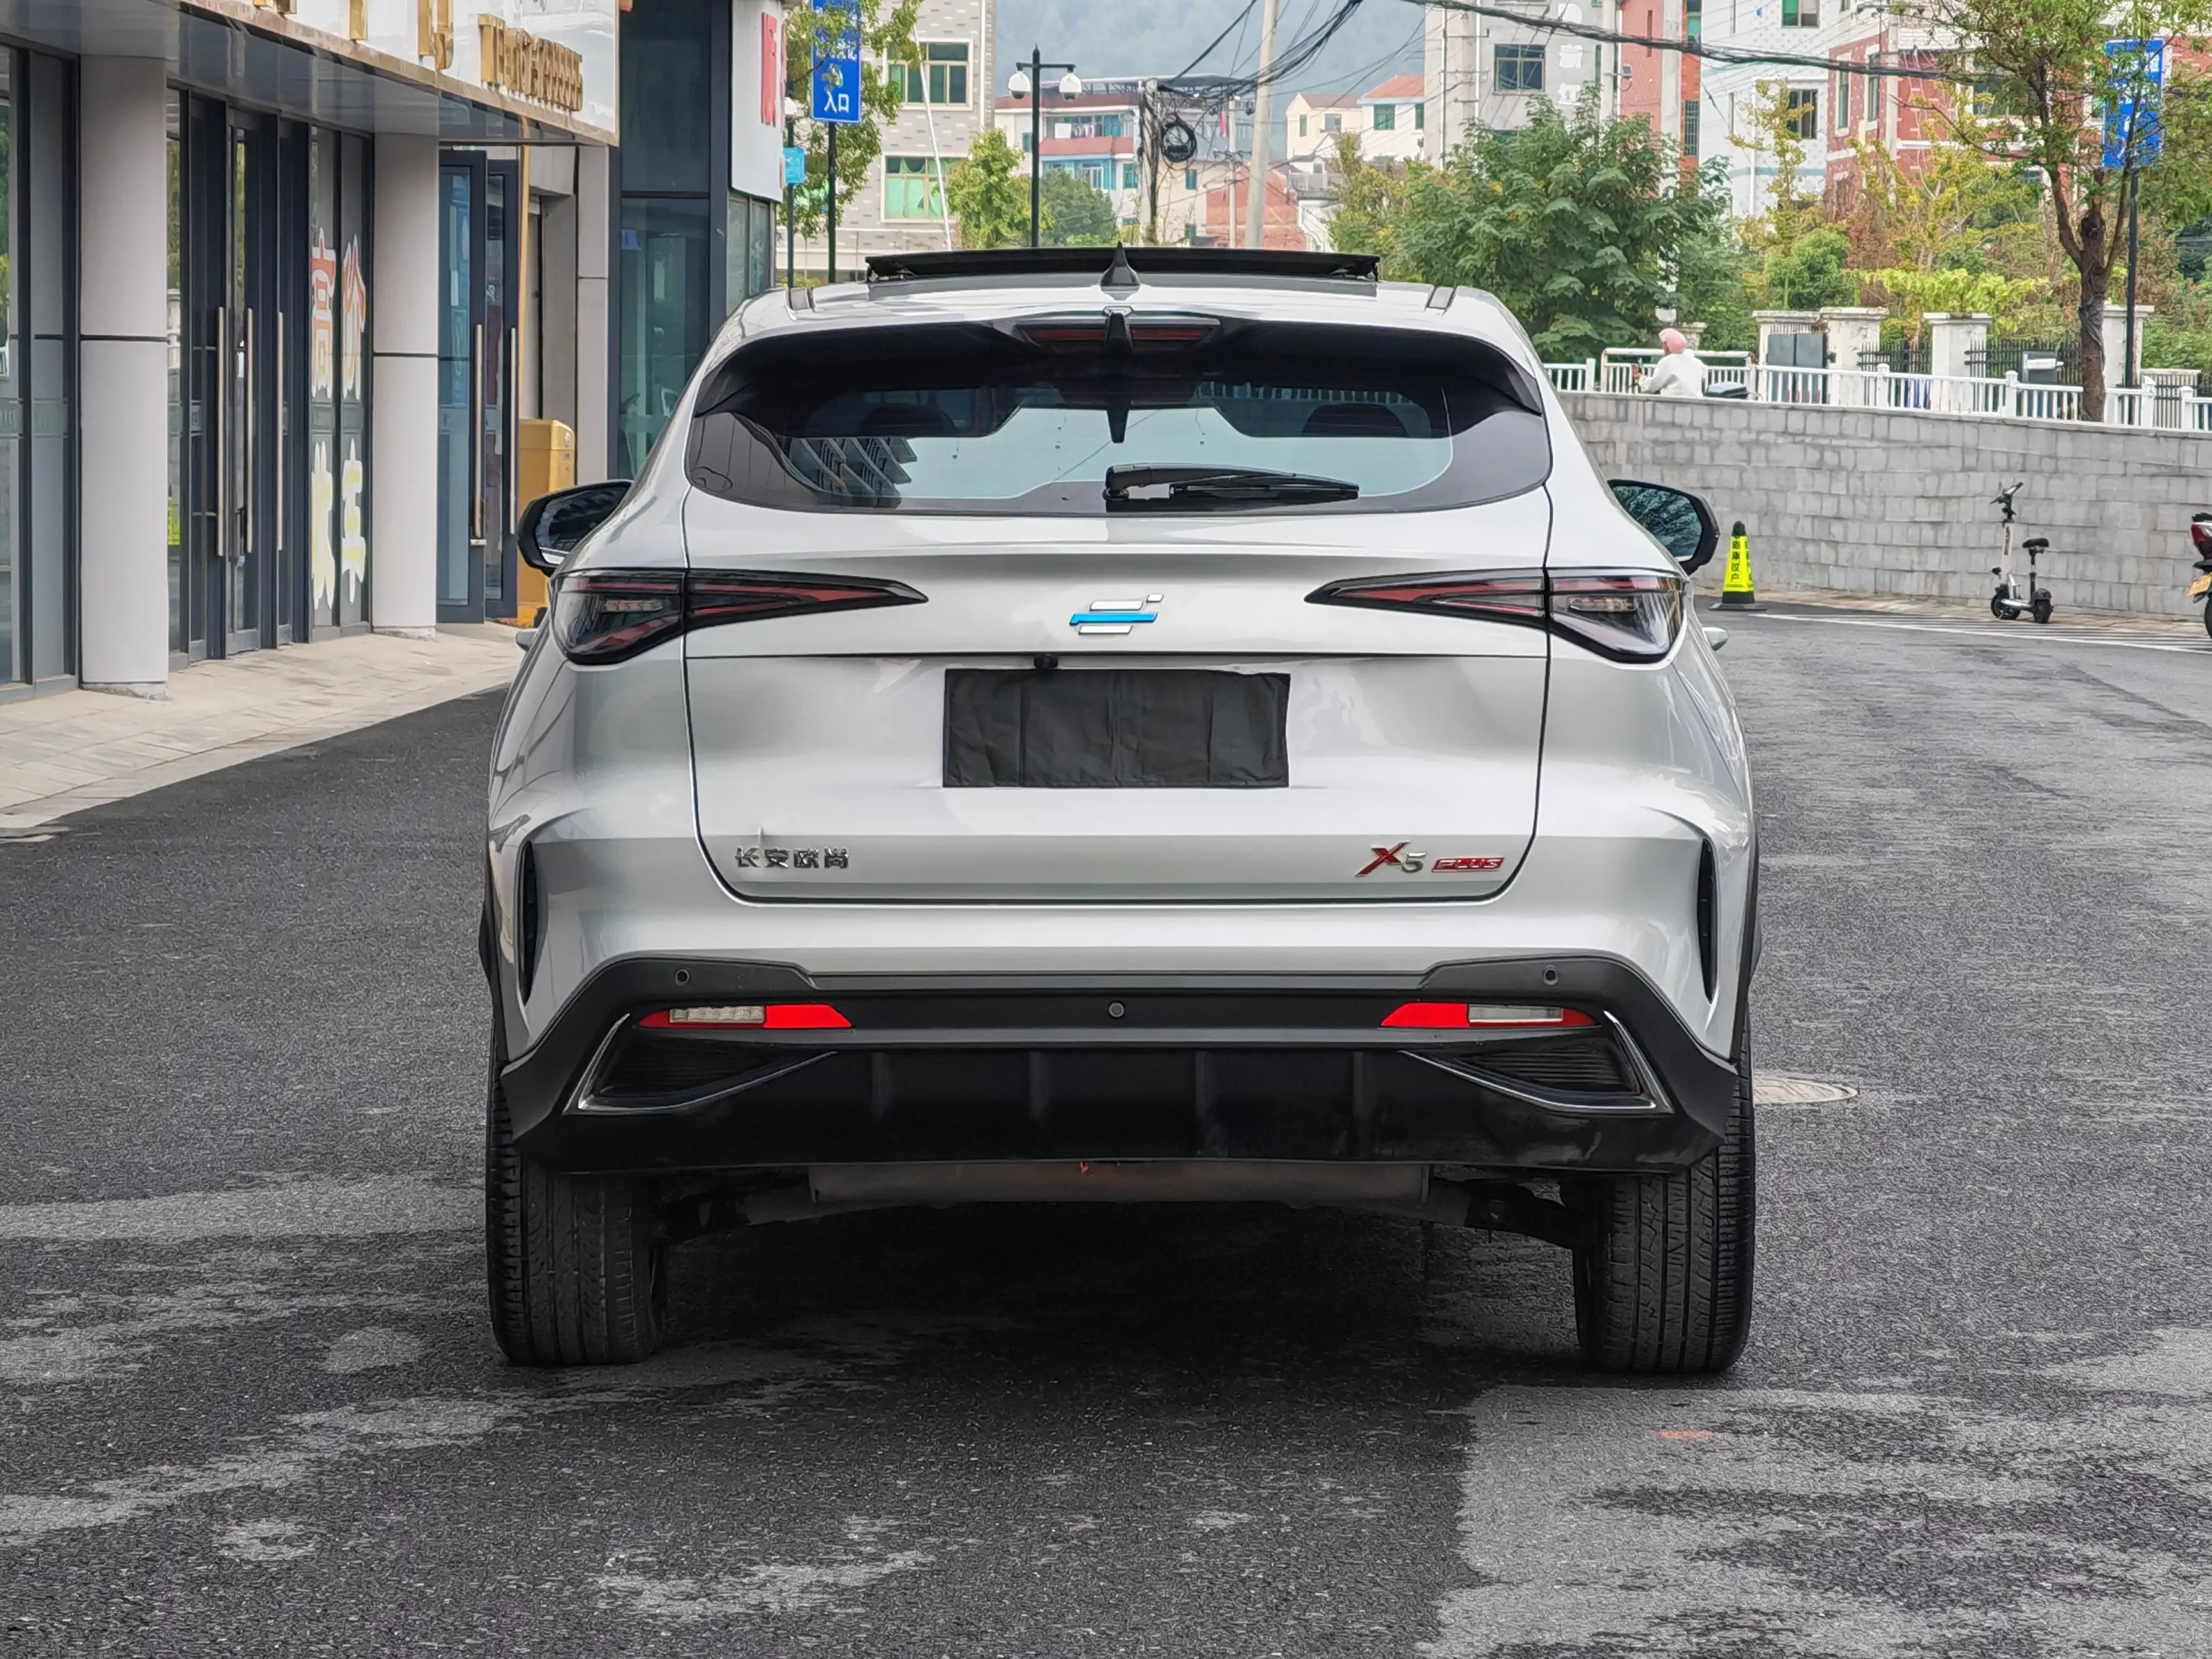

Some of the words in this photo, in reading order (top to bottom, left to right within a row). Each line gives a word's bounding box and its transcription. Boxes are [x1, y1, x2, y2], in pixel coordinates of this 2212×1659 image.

[824, 90, 849, 113] 入口
[735, 846, 849, 868] 长安欧尚
[1354, 840, 1428, 877] X5
